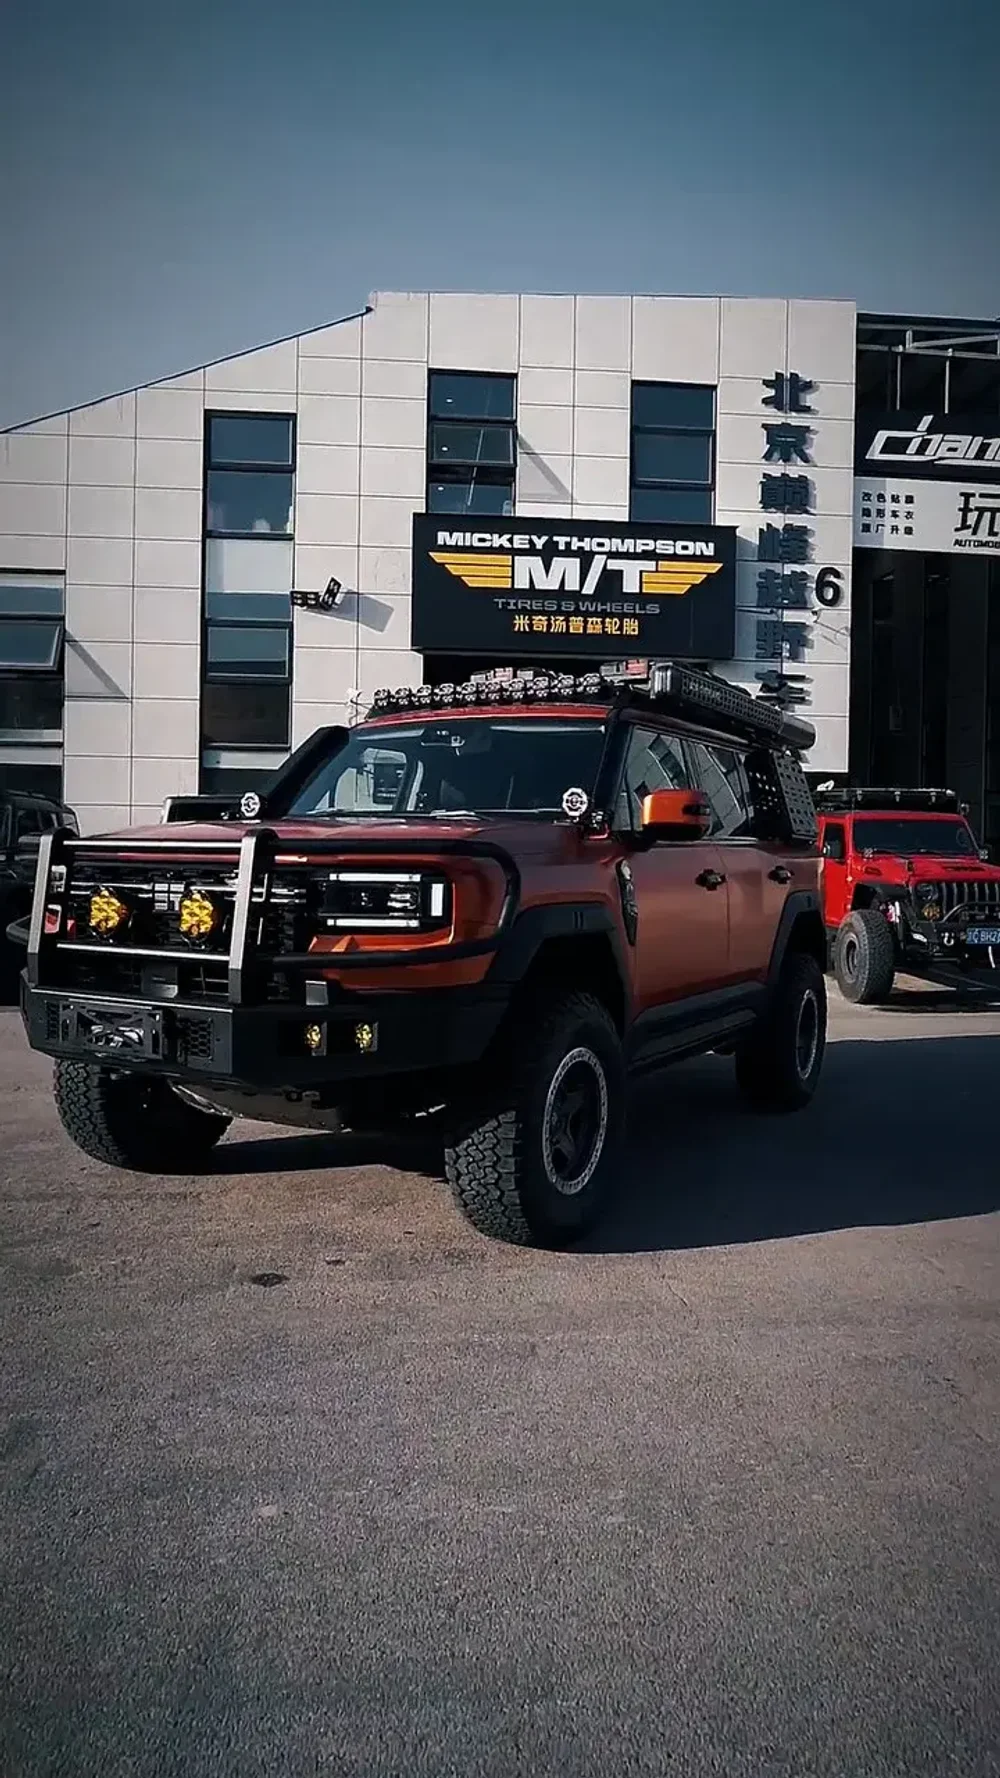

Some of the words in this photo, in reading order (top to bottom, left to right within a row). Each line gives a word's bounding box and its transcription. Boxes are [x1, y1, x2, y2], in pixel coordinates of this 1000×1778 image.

[437, 531, 548, 549] MICKEY
[552, 536, 715, 556] THOMPSON
[513, 554, 657, 594] M/T
[815, 566, 842, 607] 6
[493, 598, 558, 611] TIRES
[561, 601, 575, 611] &
[578, 601, 660, 614] WHEELS
[513, 615, 639, 636] 米奇汤普森轮胎
